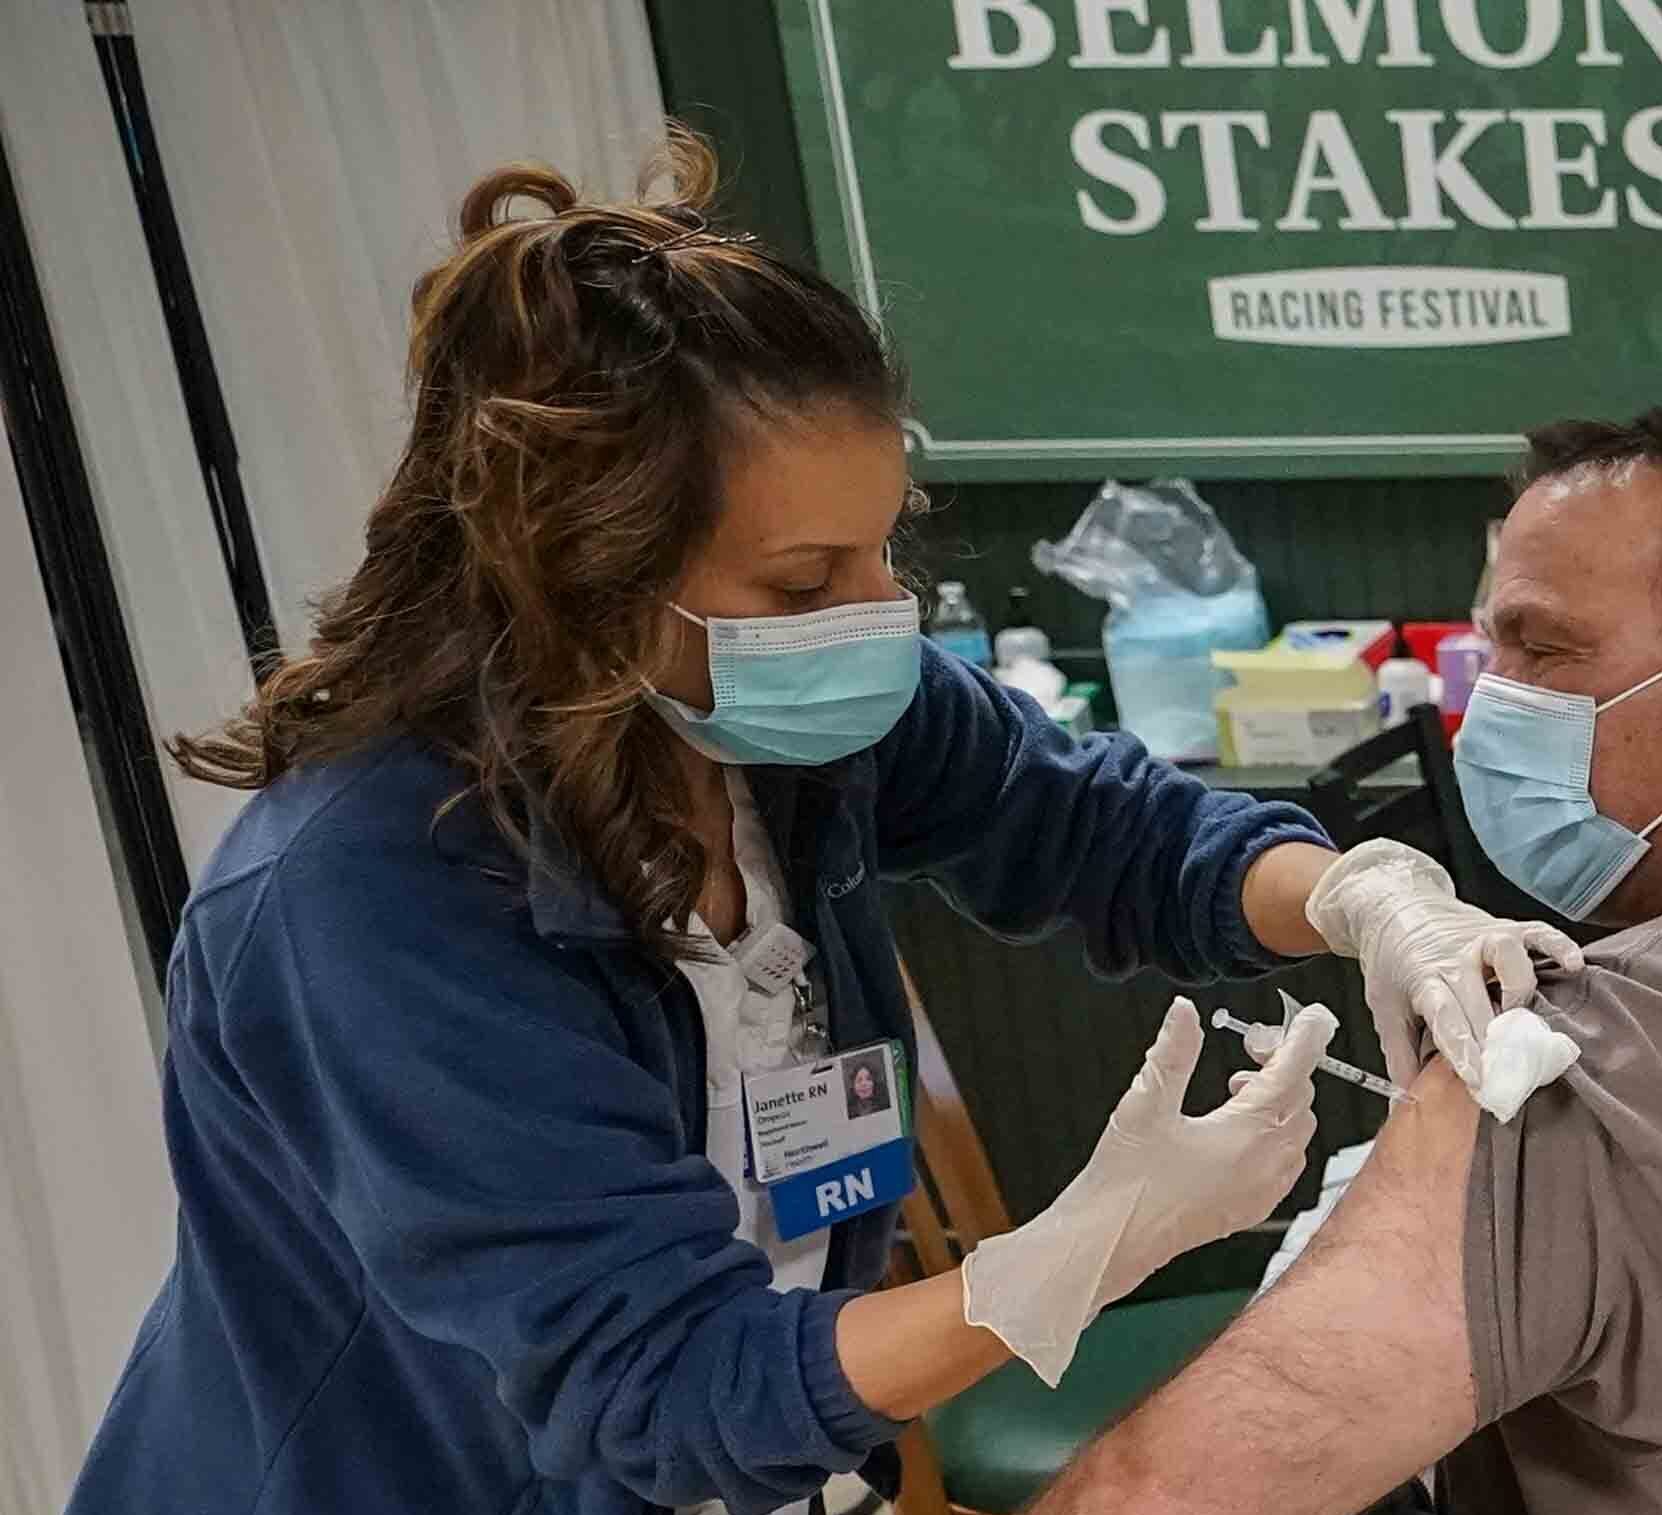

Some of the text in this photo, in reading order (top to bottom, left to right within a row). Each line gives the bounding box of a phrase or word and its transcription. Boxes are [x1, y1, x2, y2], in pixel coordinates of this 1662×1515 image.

[1231, 286, 1550, 331] RACING FESTIVAL
[754, 1082, 829, 1114] Janette RN
[815, 1168, 875, 1217] RN
